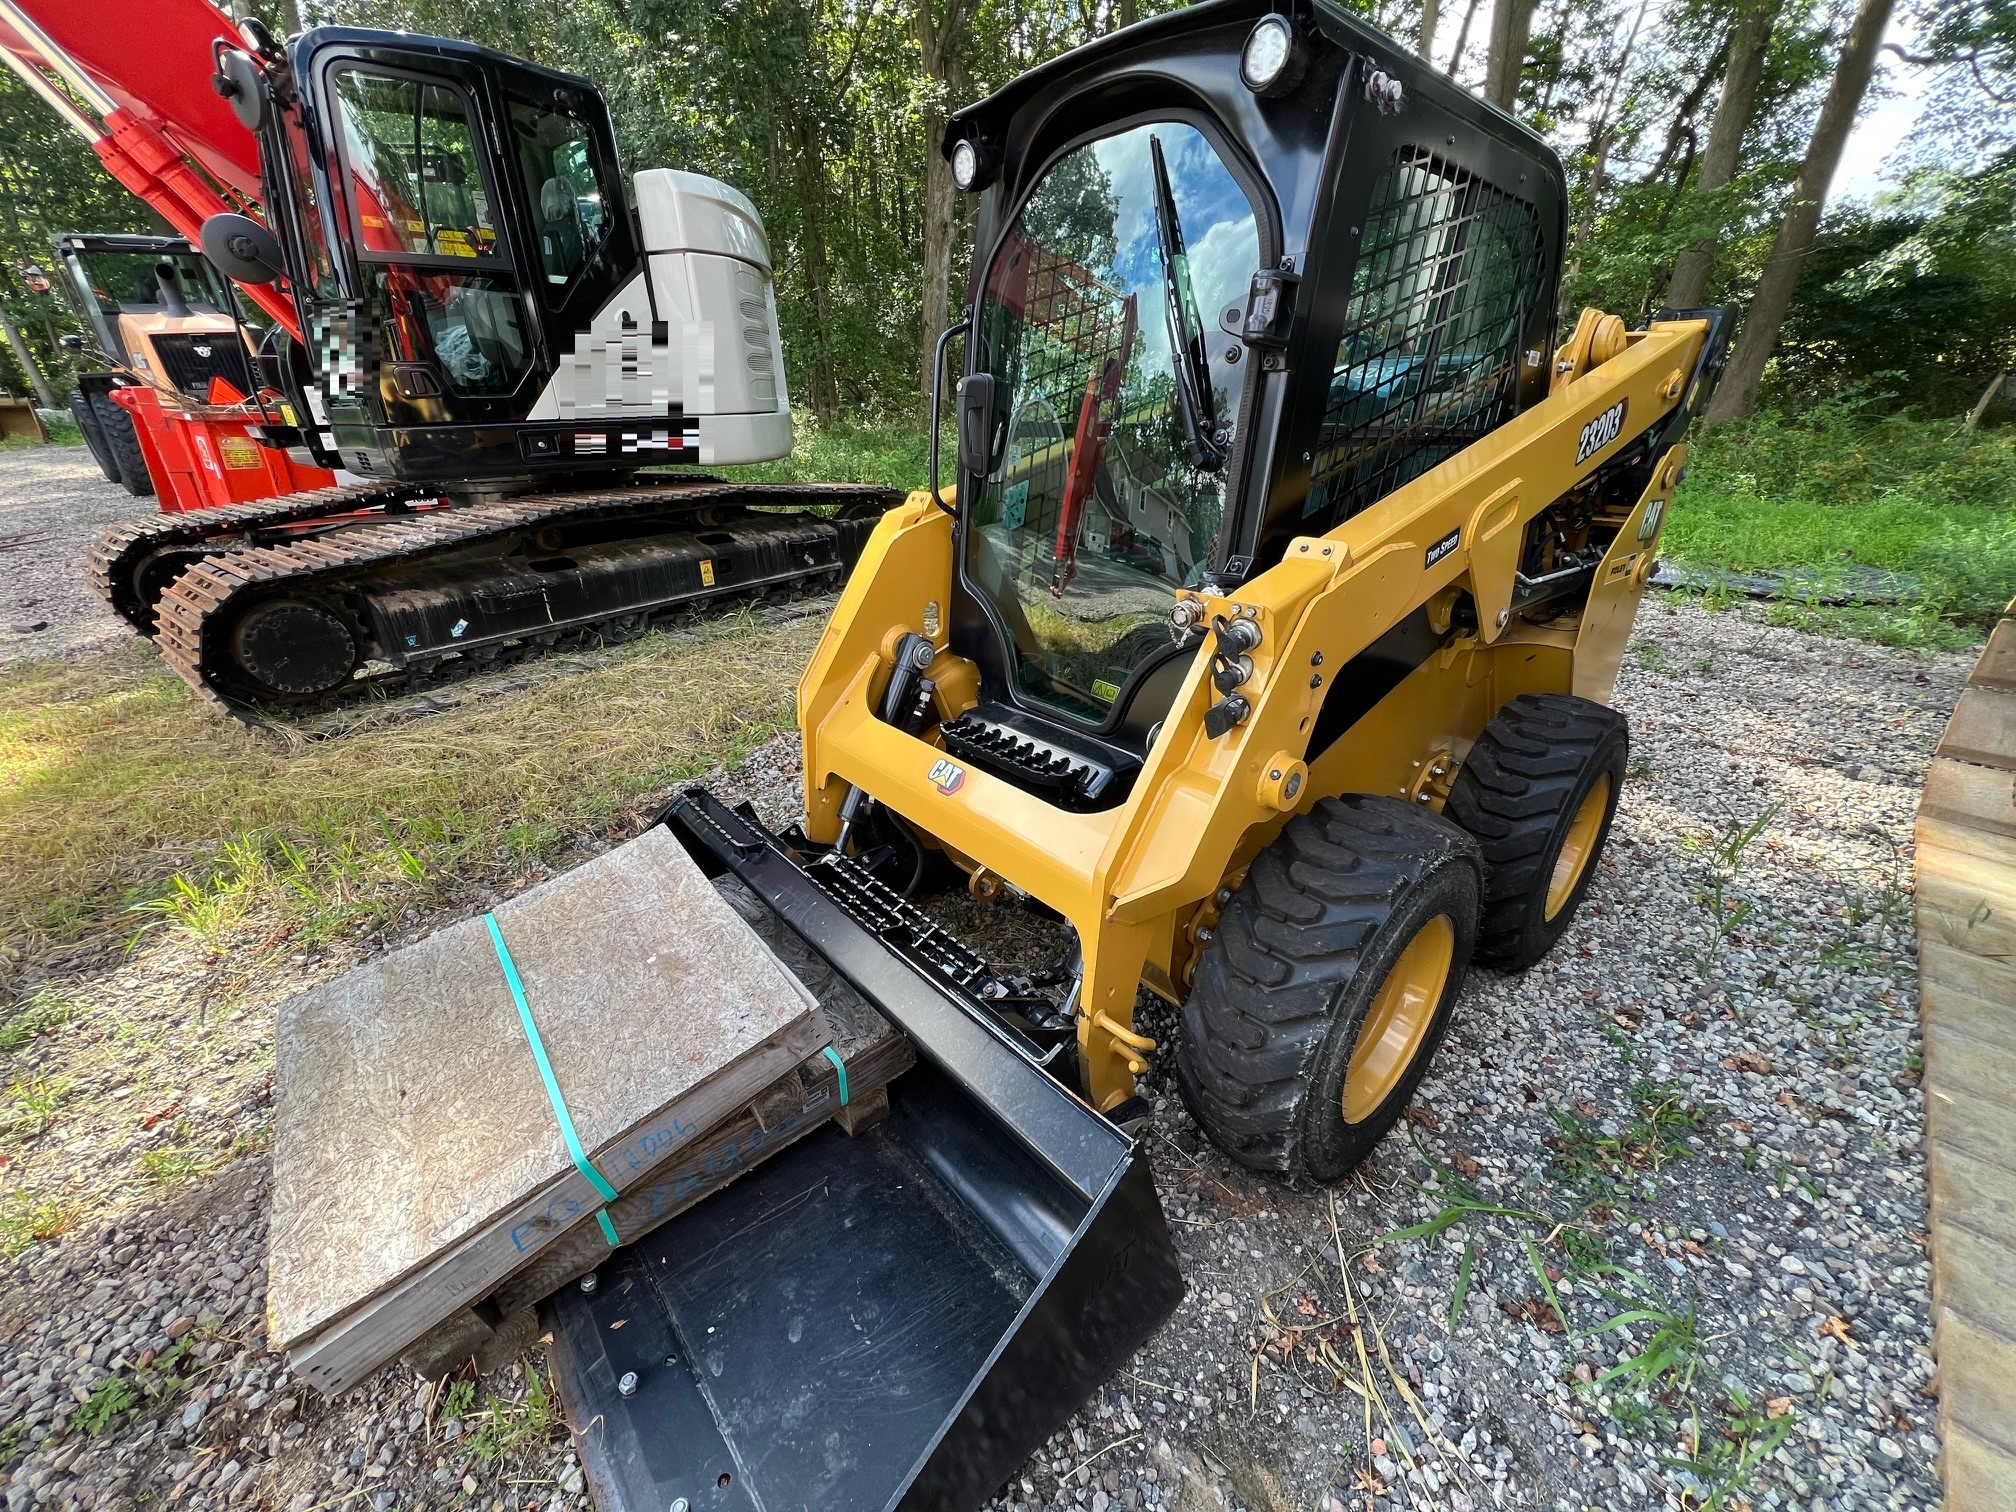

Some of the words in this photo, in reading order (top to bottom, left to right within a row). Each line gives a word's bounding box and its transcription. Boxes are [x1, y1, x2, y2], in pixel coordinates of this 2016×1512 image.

[1576, 402, 1623, 464] 232D3
[1638, 500, 1664, 540] CAT
[1609, 563, 1627, 576] FOLEY
[928, 758, 963, 789] CAT
[511, 1198, 581, 1253] EQ
